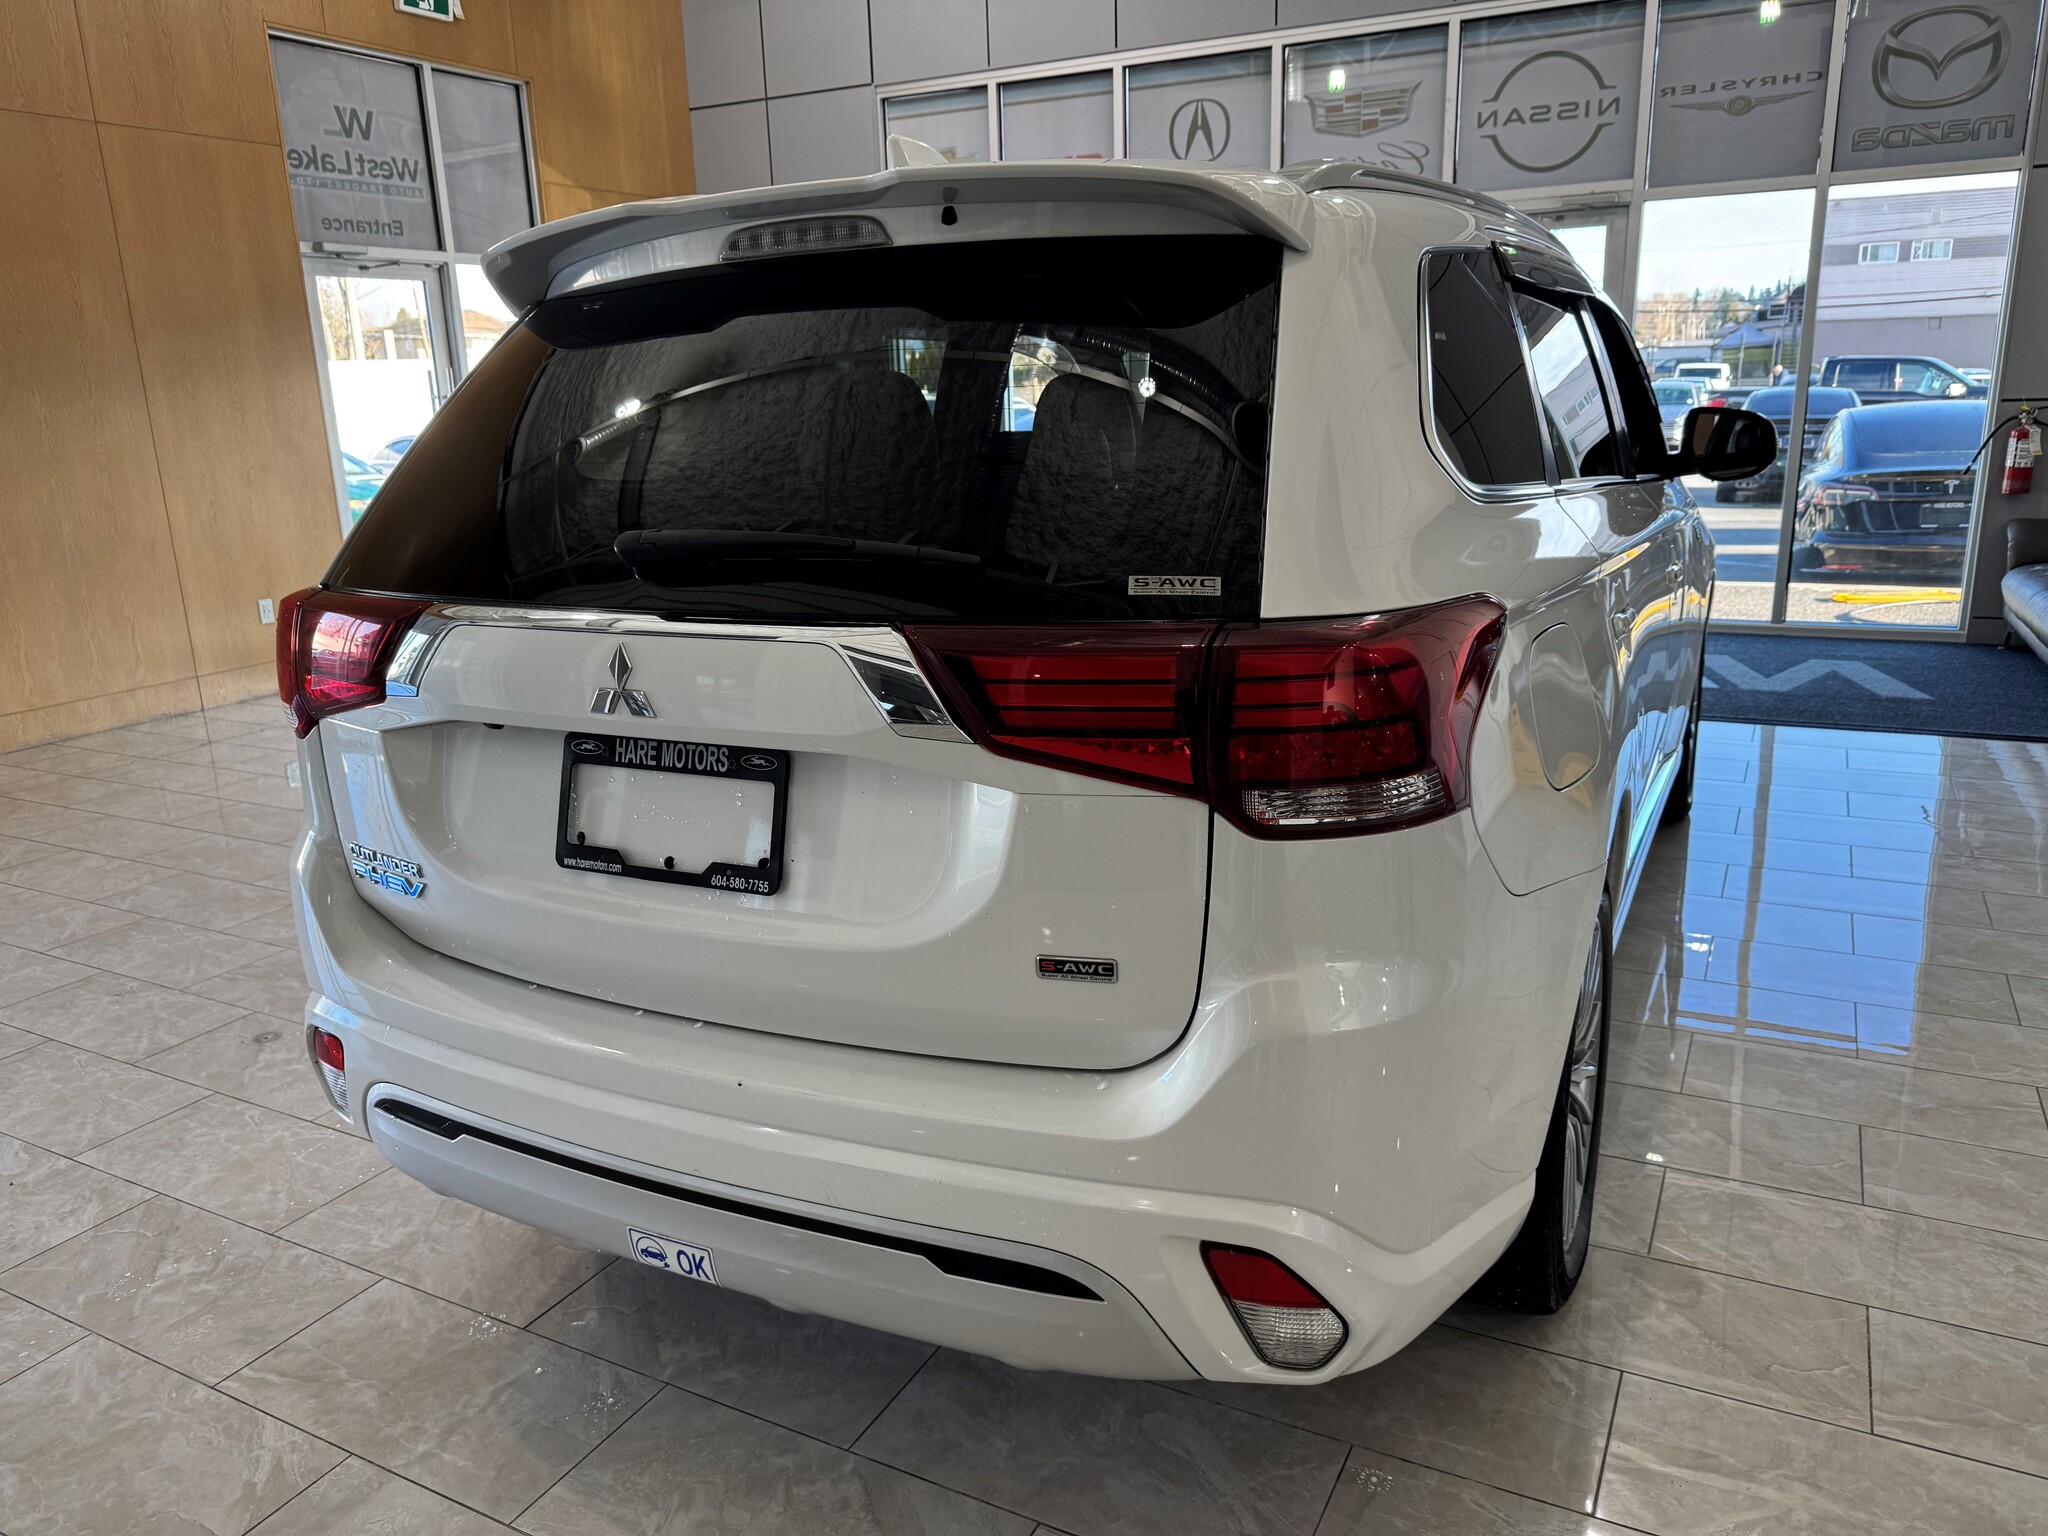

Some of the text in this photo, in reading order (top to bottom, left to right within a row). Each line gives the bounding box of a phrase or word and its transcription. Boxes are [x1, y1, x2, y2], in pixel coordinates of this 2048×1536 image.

[1133, 577, 1216, 589] S-AWC
[614, 738, 729, 773] HARE MOTORS
[351, 859, 427, 899] PHEV
[710, 874, 769, 893] 604-580-7755
[1041, 961, 1113, 975] S-AWC
[676, 1249, 712, 1281] OK
